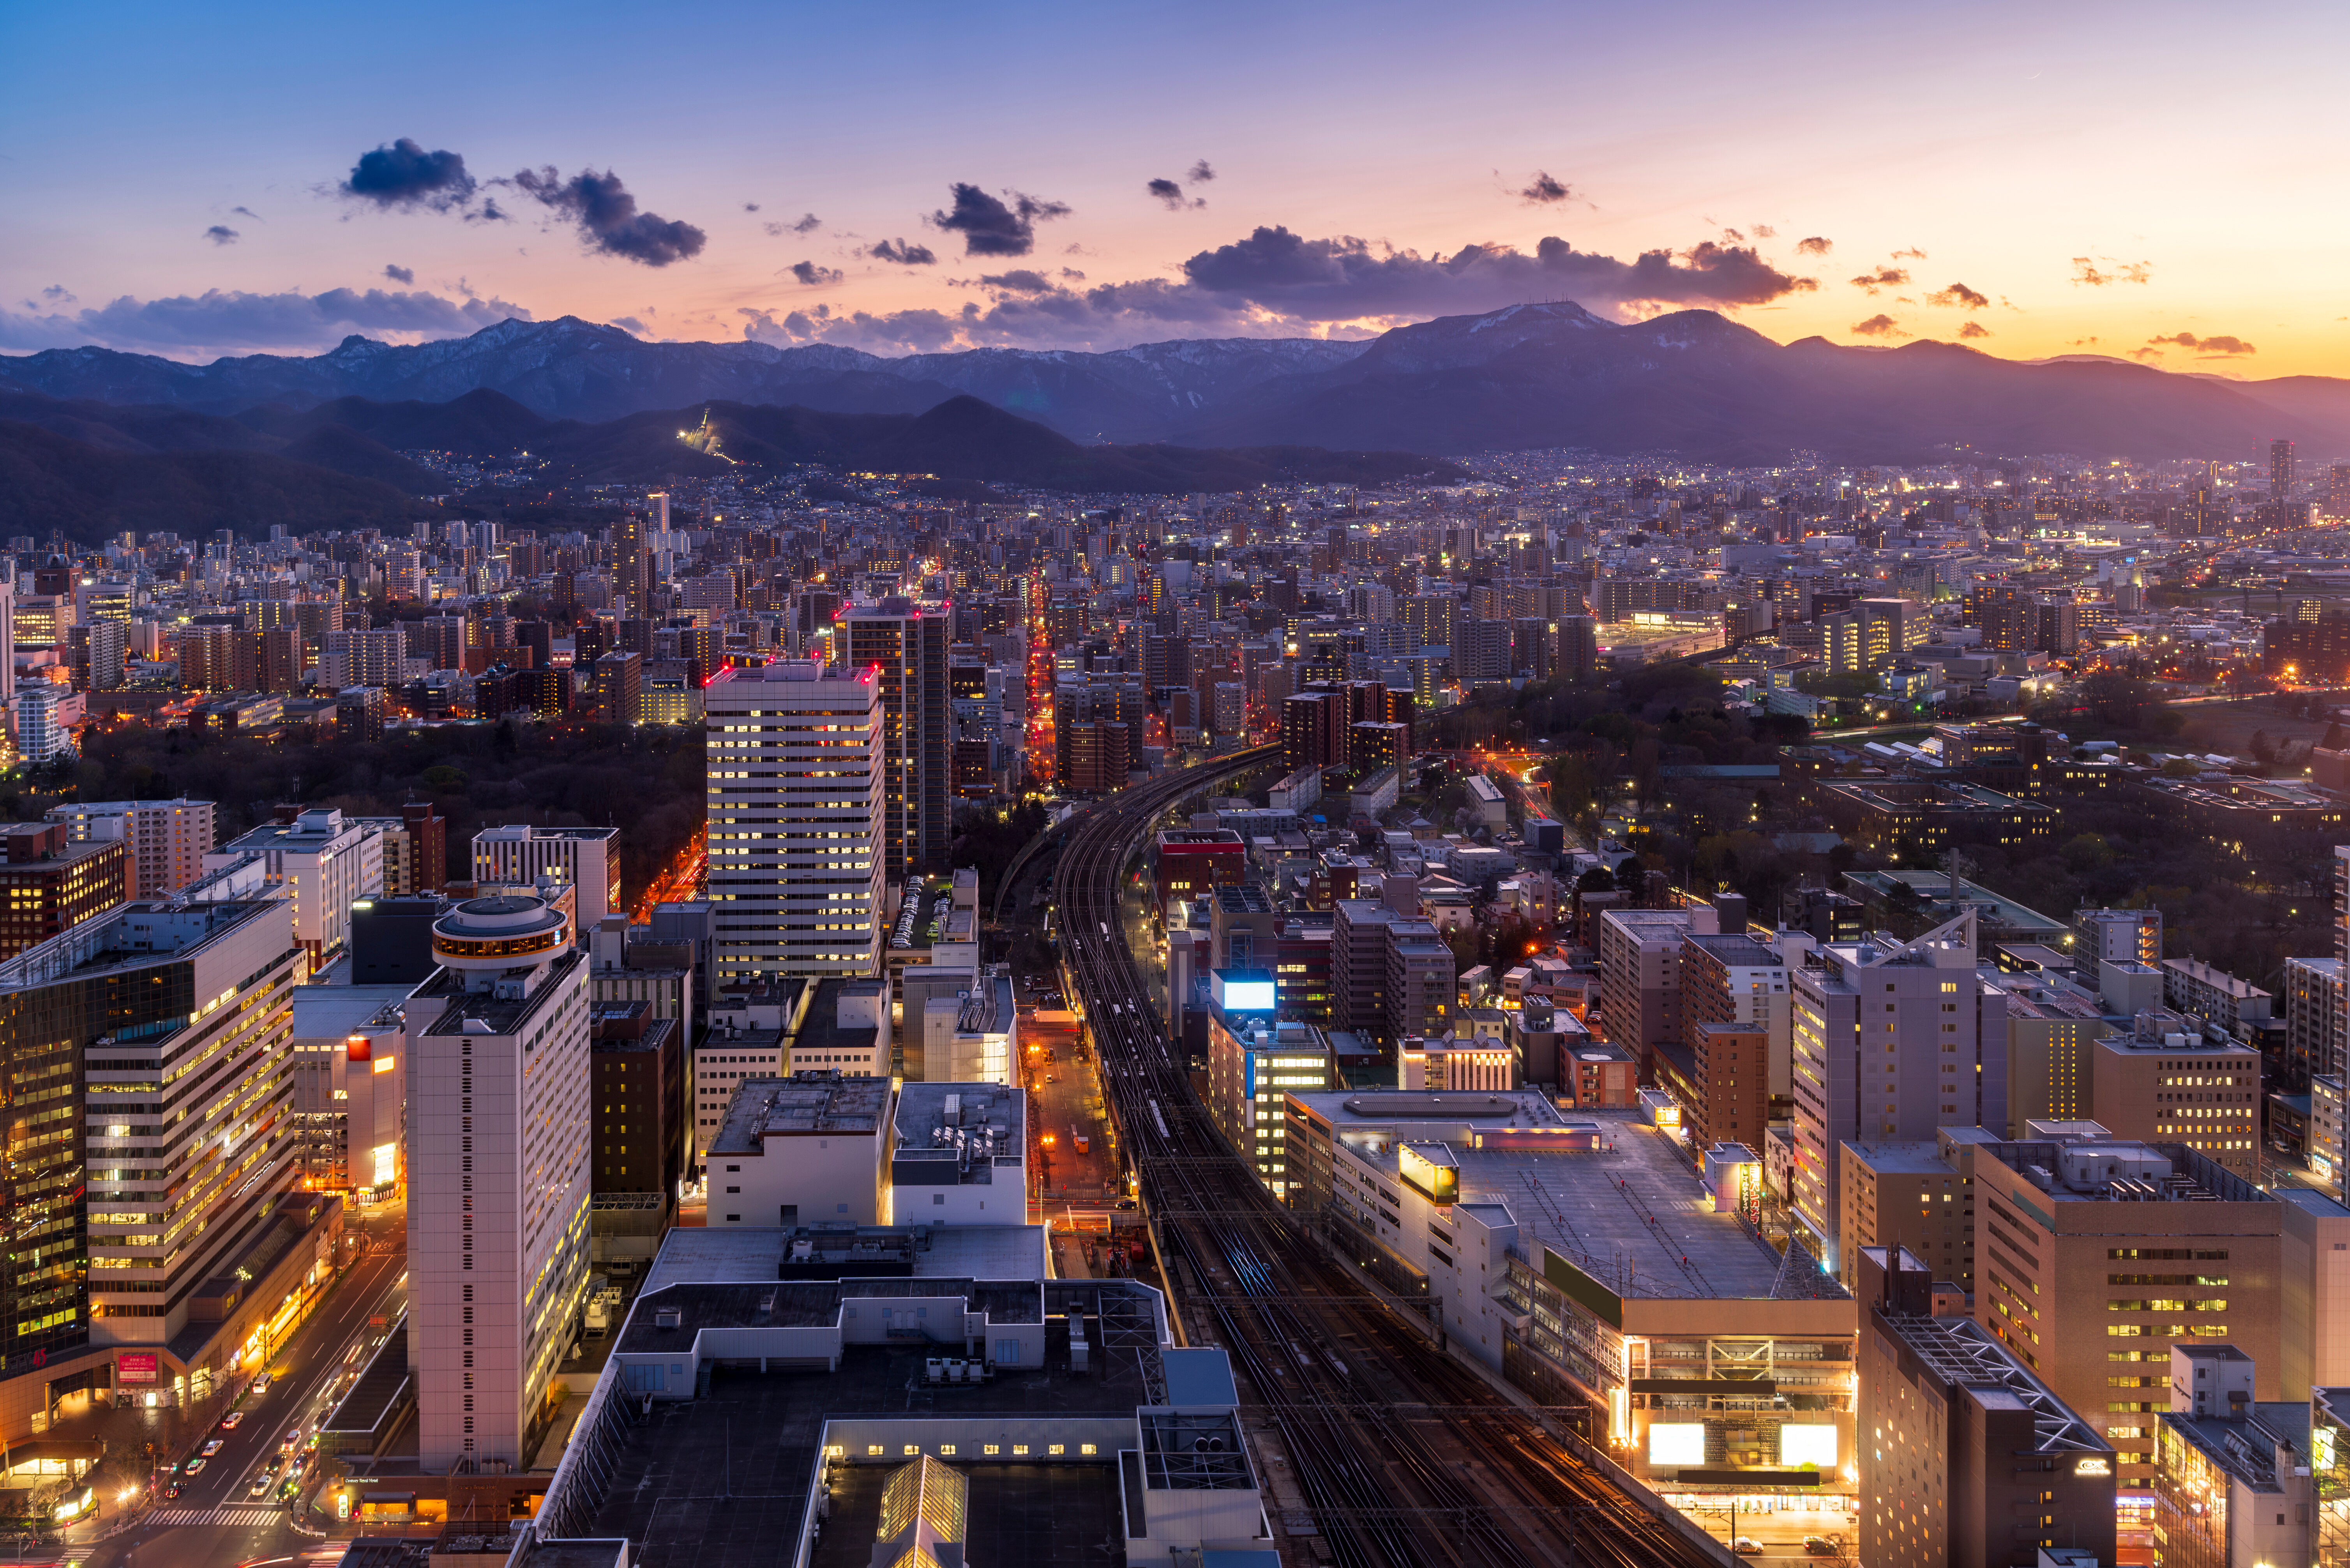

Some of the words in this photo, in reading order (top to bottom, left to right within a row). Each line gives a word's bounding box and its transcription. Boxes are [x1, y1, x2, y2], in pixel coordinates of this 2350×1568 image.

[1749, 1165, 1760, 1224] ヨドバシカメラ
